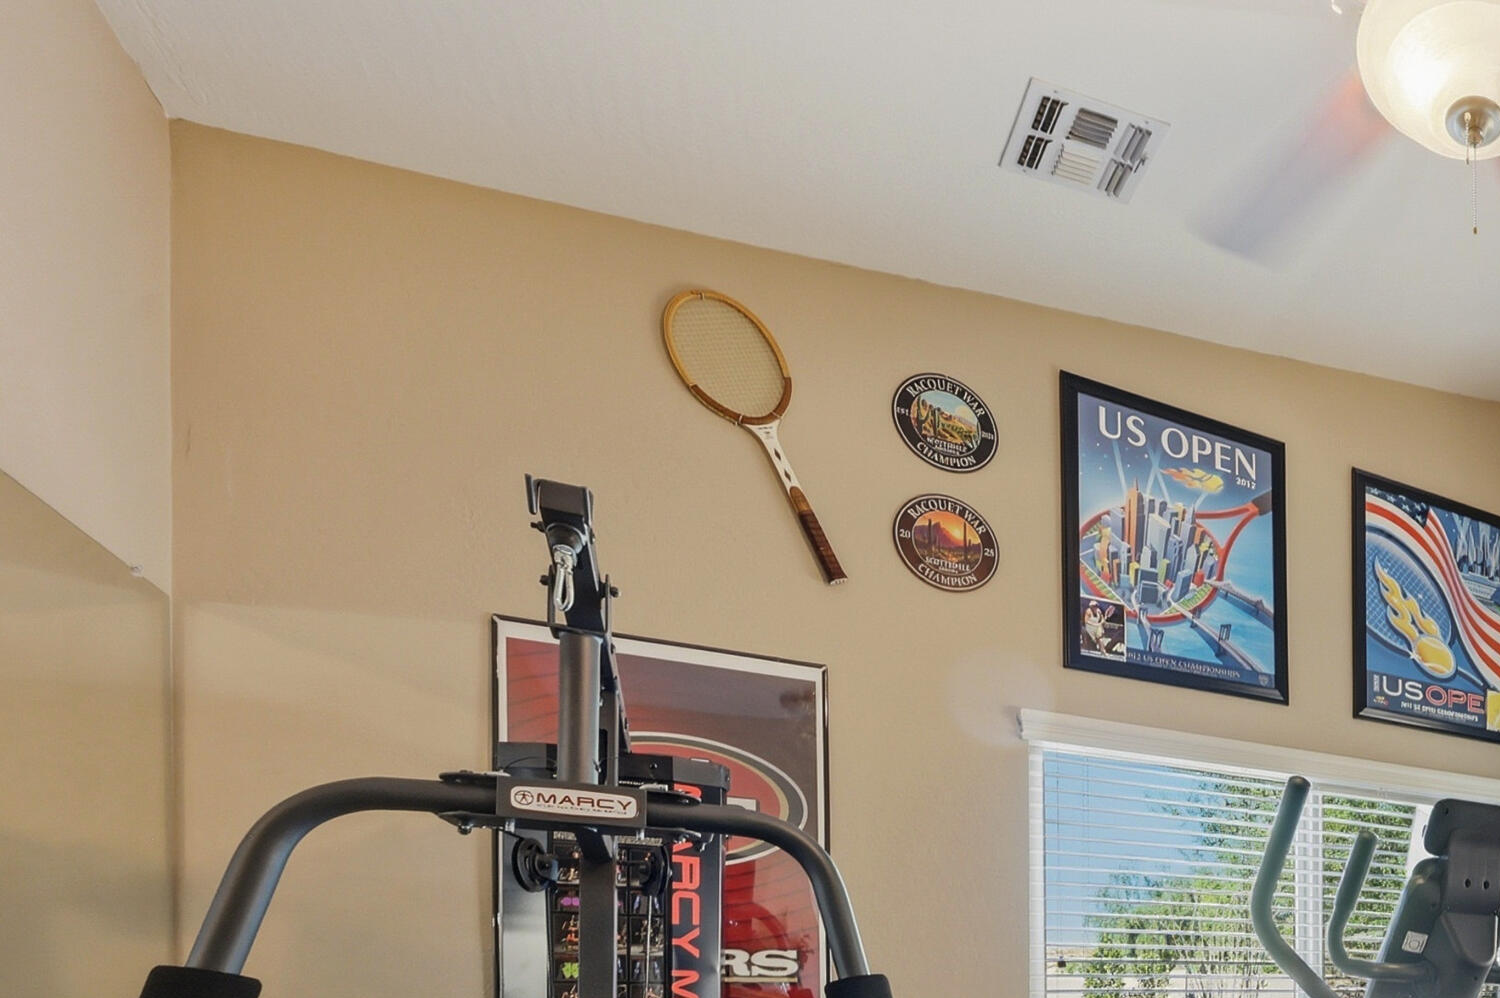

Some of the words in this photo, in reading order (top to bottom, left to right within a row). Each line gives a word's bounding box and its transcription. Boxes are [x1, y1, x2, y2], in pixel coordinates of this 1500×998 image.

[906, 379, 962, 398] RACQUET
[963, 391, 985, 417] WAR
[916, 441, 977, 467] CHAMPION
[1099, 405, 1146, 447] US
[1161, 427, 1256, 481] OPEN
[907, 499, 962, 519] RACQUET
[964, 510, 987, 534] WAR
[899, 529, 911, 538] 20
[918, 563, 978, 586] CHAMPION
[1425, 685, 1485, 714] OPE
[536, 792, 633, 811] MARCY
